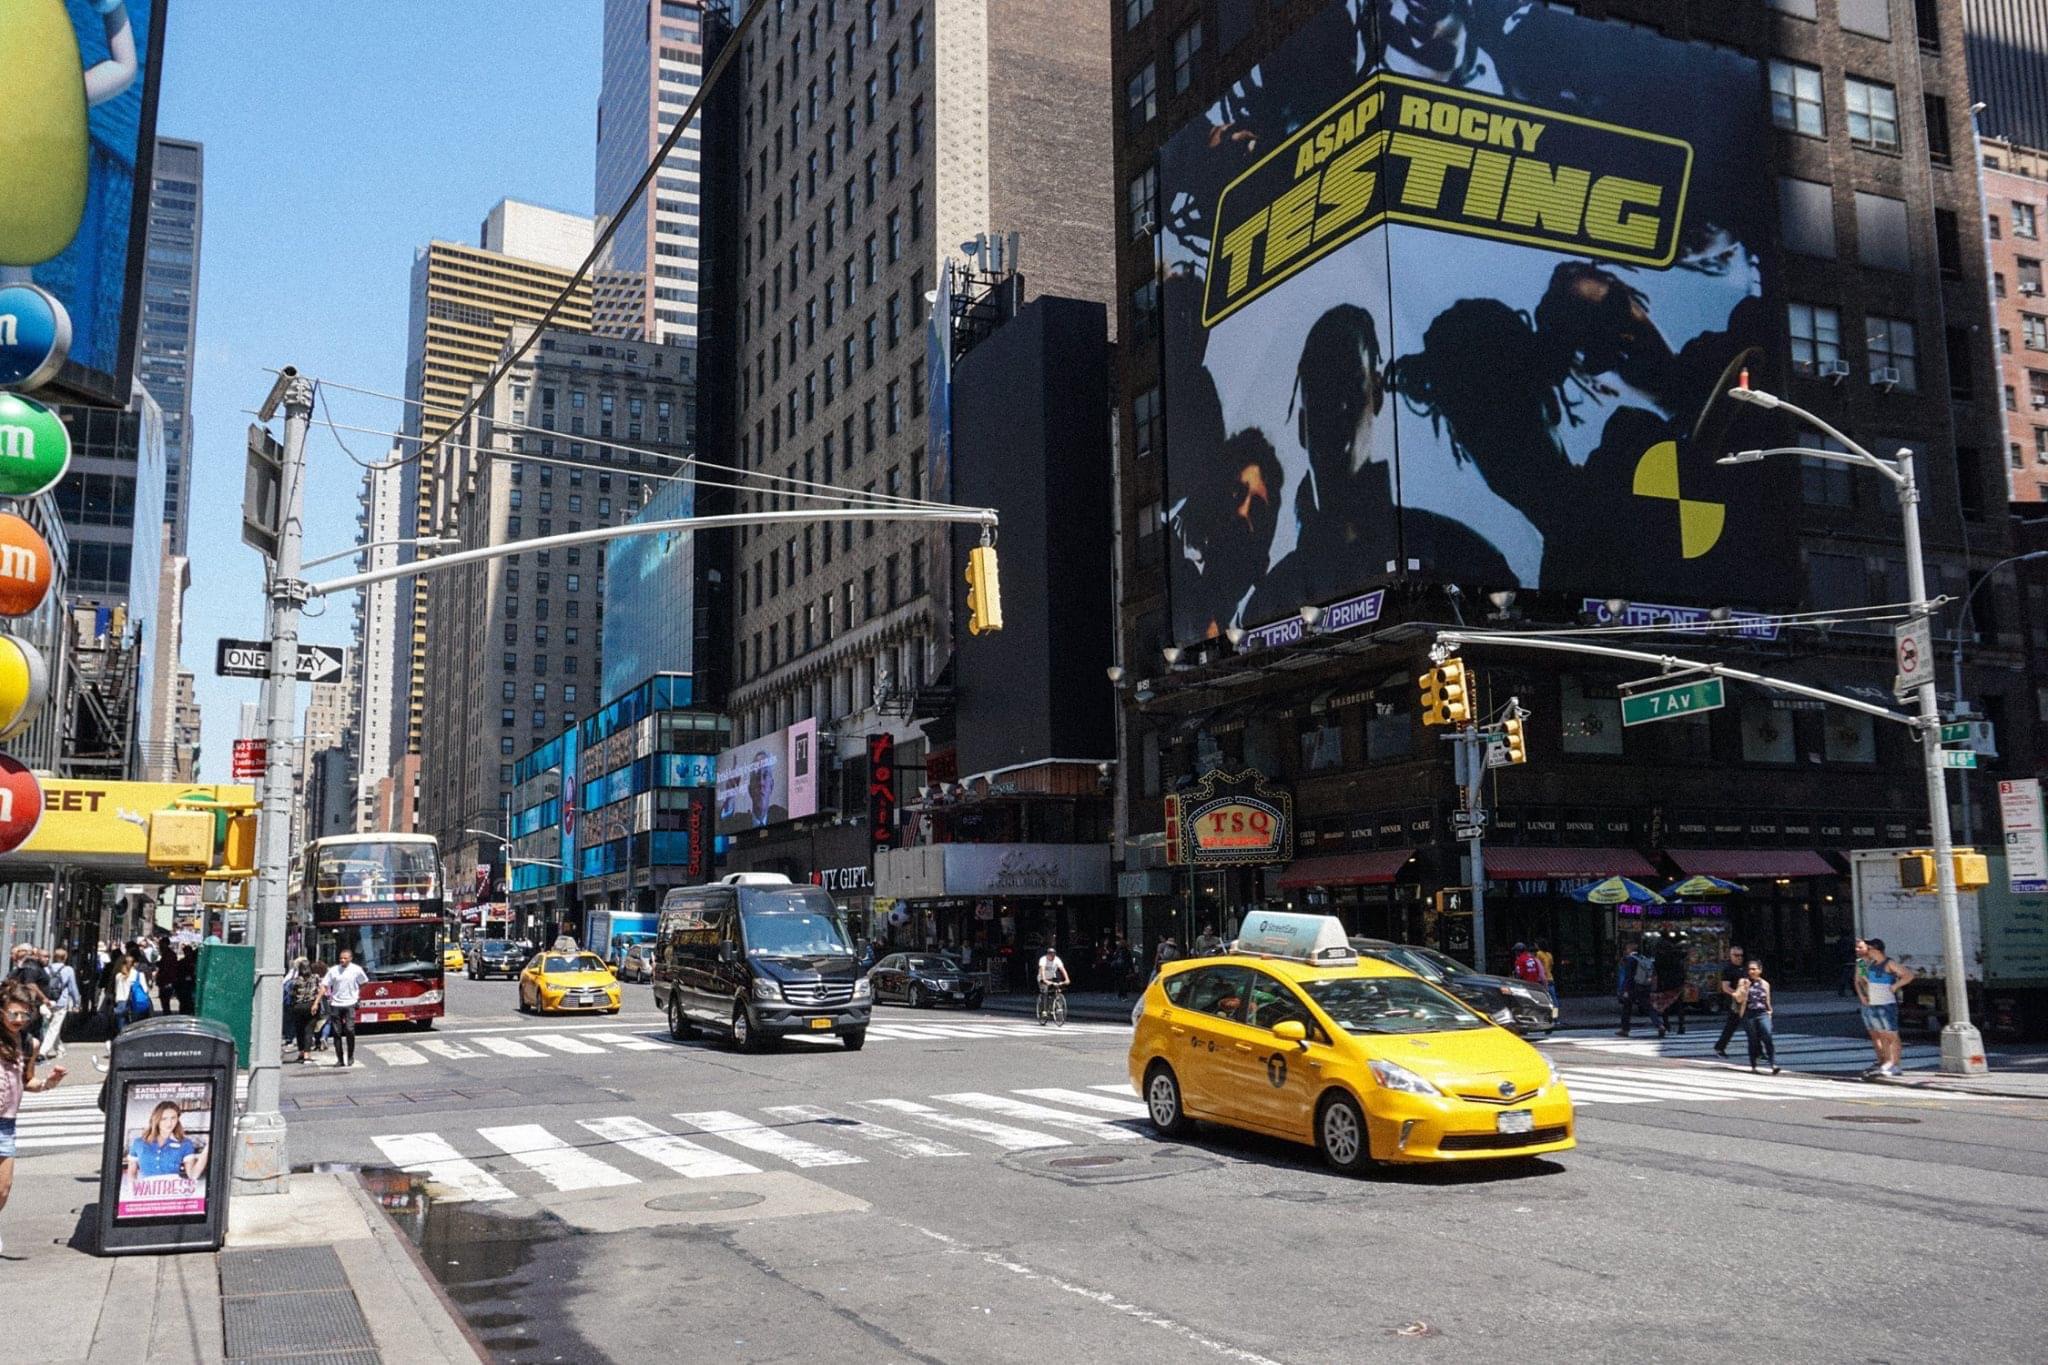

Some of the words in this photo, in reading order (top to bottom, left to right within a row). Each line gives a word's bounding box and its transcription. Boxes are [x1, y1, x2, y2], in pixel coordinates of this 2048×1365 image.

[1400, 94, 1546, 152] ROCKY
[1221, 130, 1663, 298] TESTING
[0, 423, 34, 460] m
[0, 543, 36, 583] m
[1333, 598, 1375, 627] PRIME
[229, 651, 266, 667] ONE
[1650, 698, 1660, 714] 7
[796, 738, 807, 760] FT
[1209, 811, 1270, 835] TSQ
[1352, 828, 1372, 838] LUNCH
[1380, 824, 1401, 834] DINNER
[1412, 820, 1430, 831] CAFE
[1527, 821, 1555, 830] LUNCH
[1566, 822, 1594, 830] DINNER
[1608, 823, 1629, 832] CAFE
[689, 801, 704, 877] Superdry
[822, 870, 838, 891] NY
[133, 1179, 196, 1196] WAITRESS
